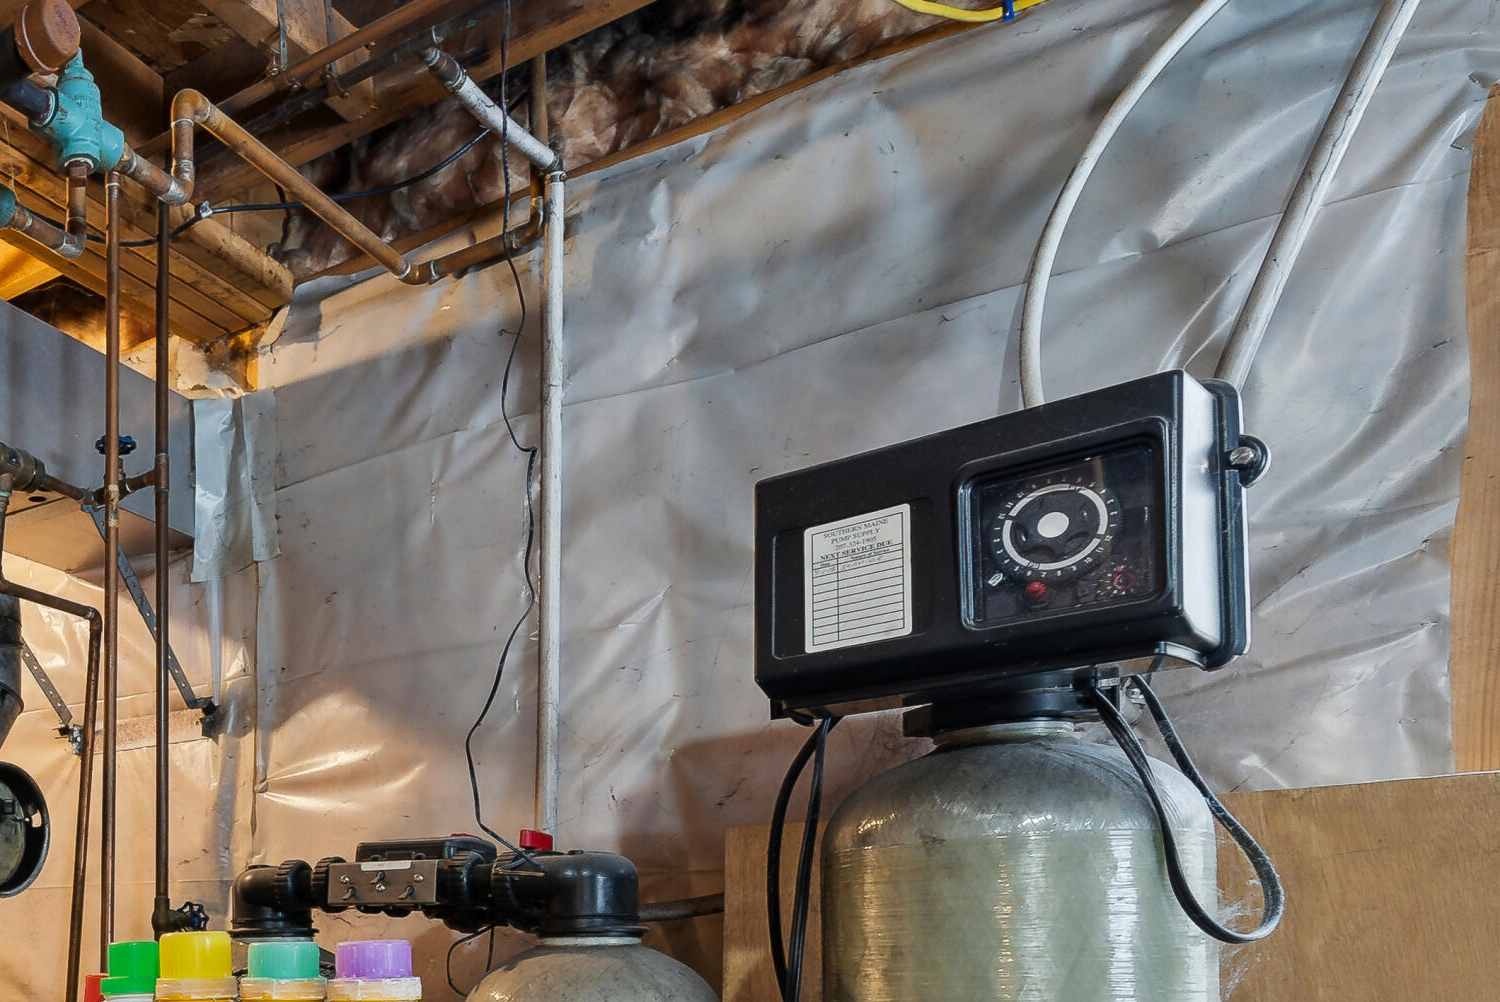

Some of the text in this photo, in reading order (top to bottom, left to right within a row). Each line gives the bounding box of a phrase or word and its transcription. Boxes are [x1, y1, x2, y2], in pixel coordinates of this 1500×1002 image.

[823, 518, 888, 539] SOUTHERN MAINE
[831, 527, 881, 544] PUMP SUPPLY
[820, 540, 893, 560] NEXT SERVICE DUE
